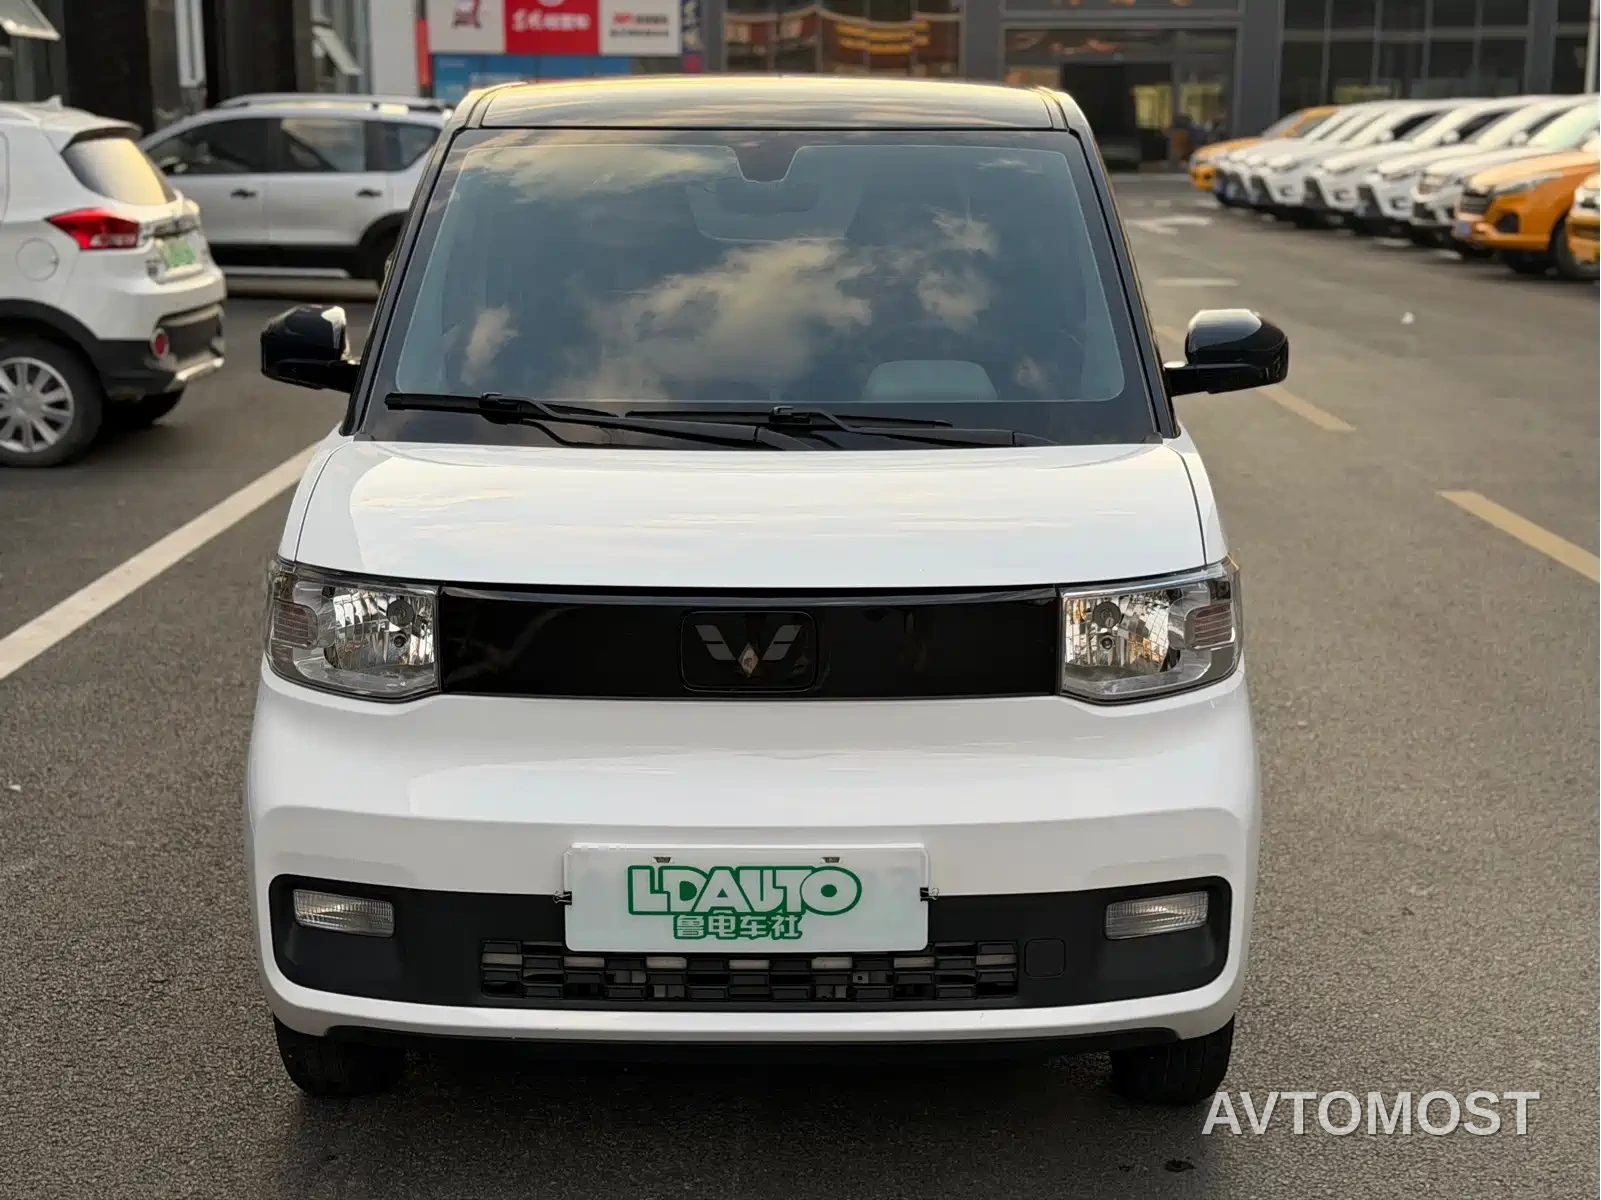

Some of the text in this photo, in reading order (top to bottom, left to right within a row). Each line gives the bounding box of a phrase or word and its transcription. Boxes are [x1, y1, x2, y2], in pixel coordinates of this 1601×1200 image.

[627, 866, 862, 915] LDAUTO
[674, 914, 803, 939] 鲁电车社
